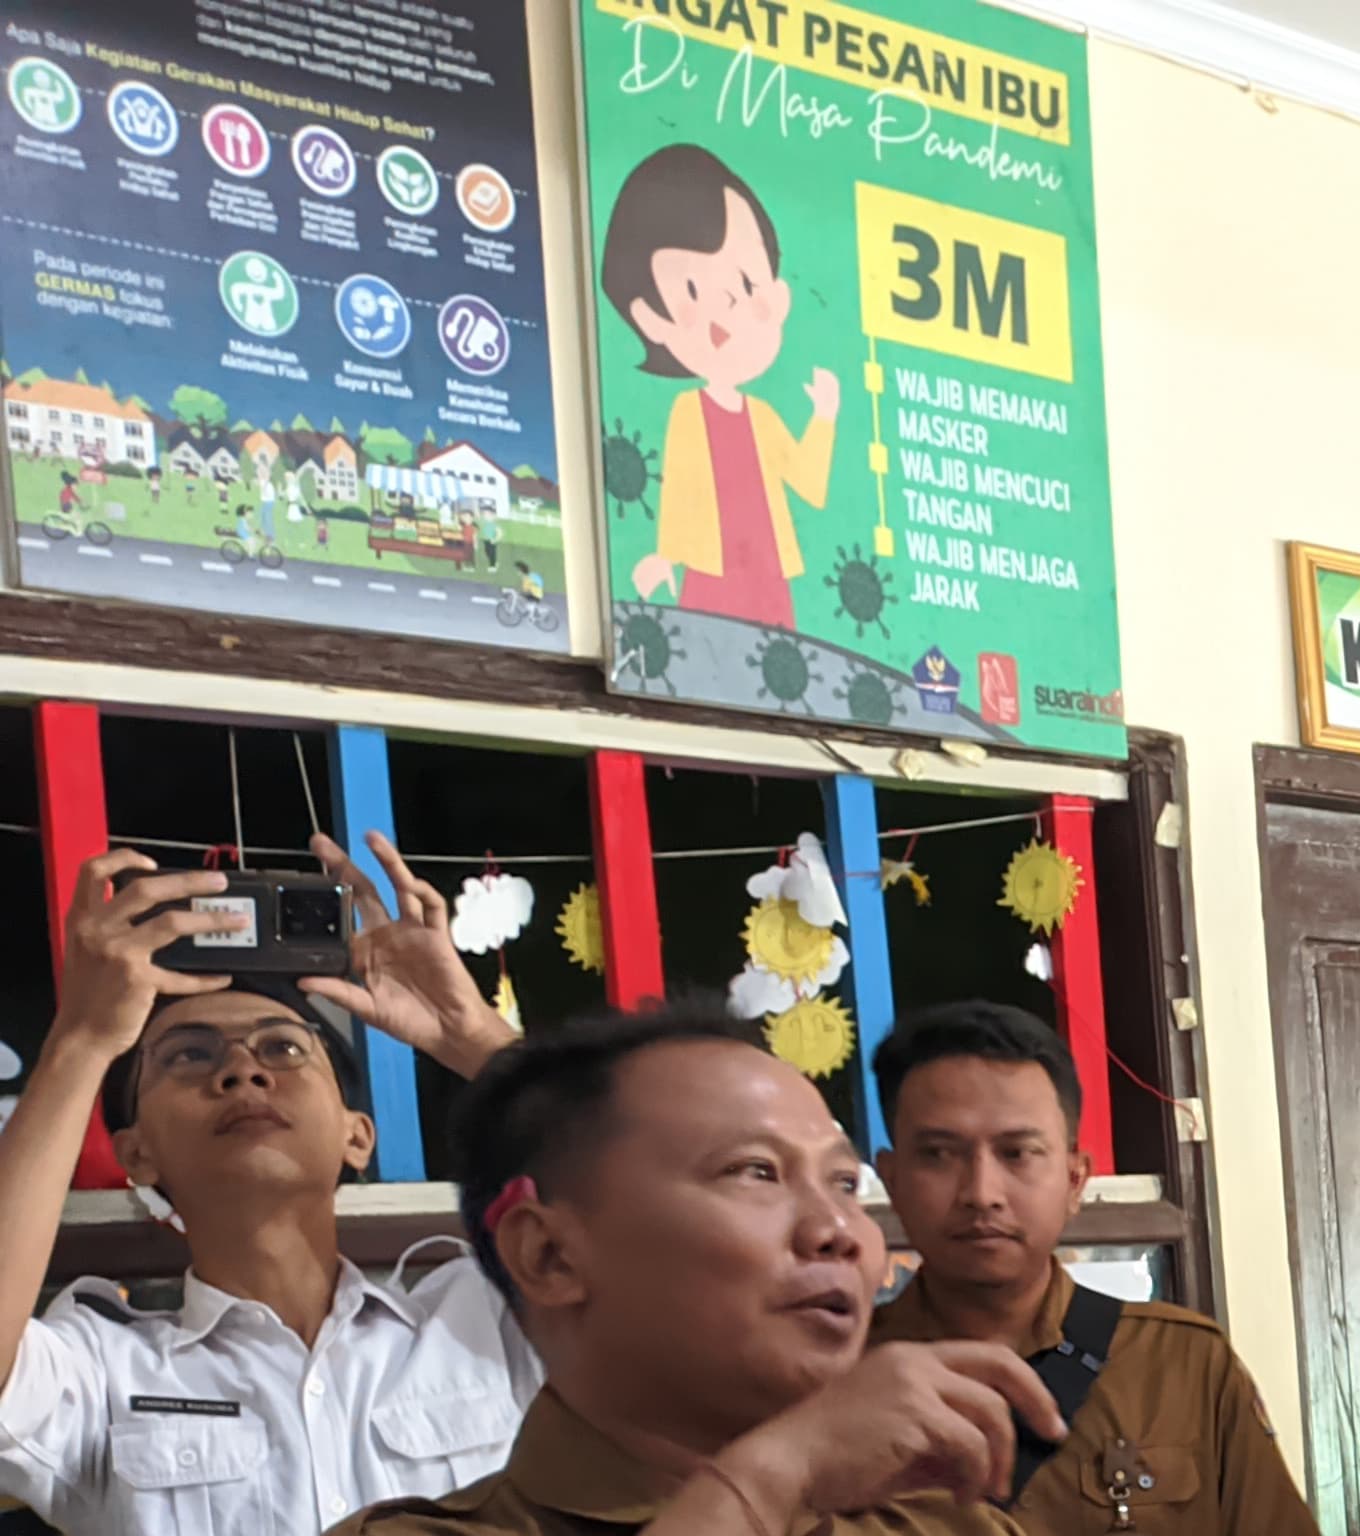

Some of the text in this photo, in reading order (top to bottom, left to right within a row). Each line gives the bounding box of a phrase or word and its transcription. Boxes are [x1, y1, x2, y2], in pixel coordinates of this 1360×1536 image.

[6, 23, 435, 142] Apa Saja Kegiatan Gerakan Masyarakat Hidup Sehat?
[615, 0, 1060, 129] GAT PESAN IBU
[619, 15, 1063, 191] Di Masa Pandemi
[33, 249, 77, 273] Pada
[80, 262, 142, 286] periode
[35, 272, 164, 312] GERMAS fokus
[890, 223, 1030, 347] 3M
[36, 290, 99, 315] dengan
[895, 367, 1068, 435] WAJIB MEMAKAI
[898, 407, 989, 457] MASKER
[900, 448, 1071, 513] WAJIB MENCUCI
[903, 488, 993, 537] TANGAN
[905, 529, 1079, 591] WAJIB MENJAGA
[910, 571, 980, 612] JARAK
